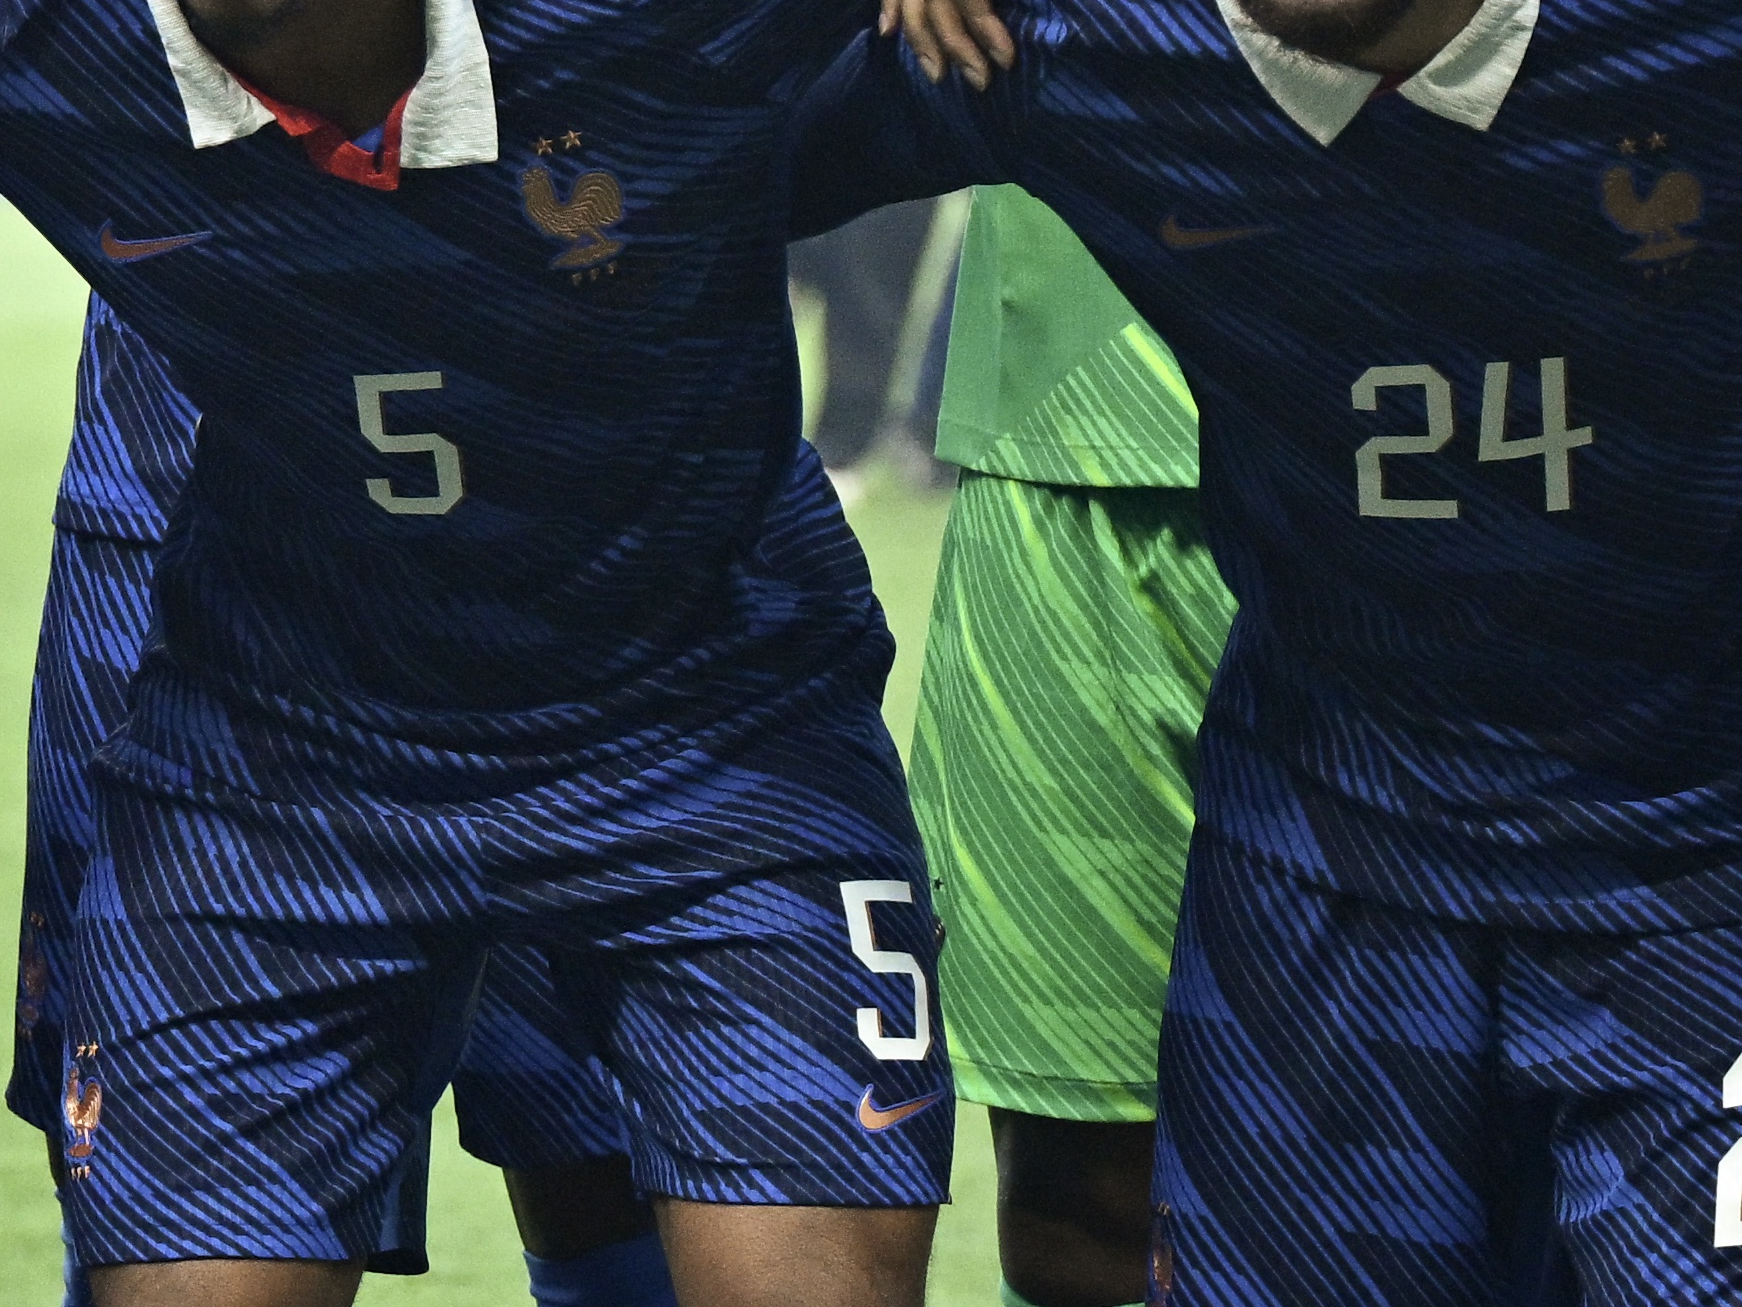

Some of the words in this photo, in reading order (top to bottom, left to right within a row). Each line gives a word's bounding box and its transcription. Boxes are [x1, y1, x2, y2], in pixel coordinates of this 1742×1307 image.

[353, 371, 463, 515] 5
[1351, 357, 1593, 519] 24
[839, 879, 932, 1061] 5
